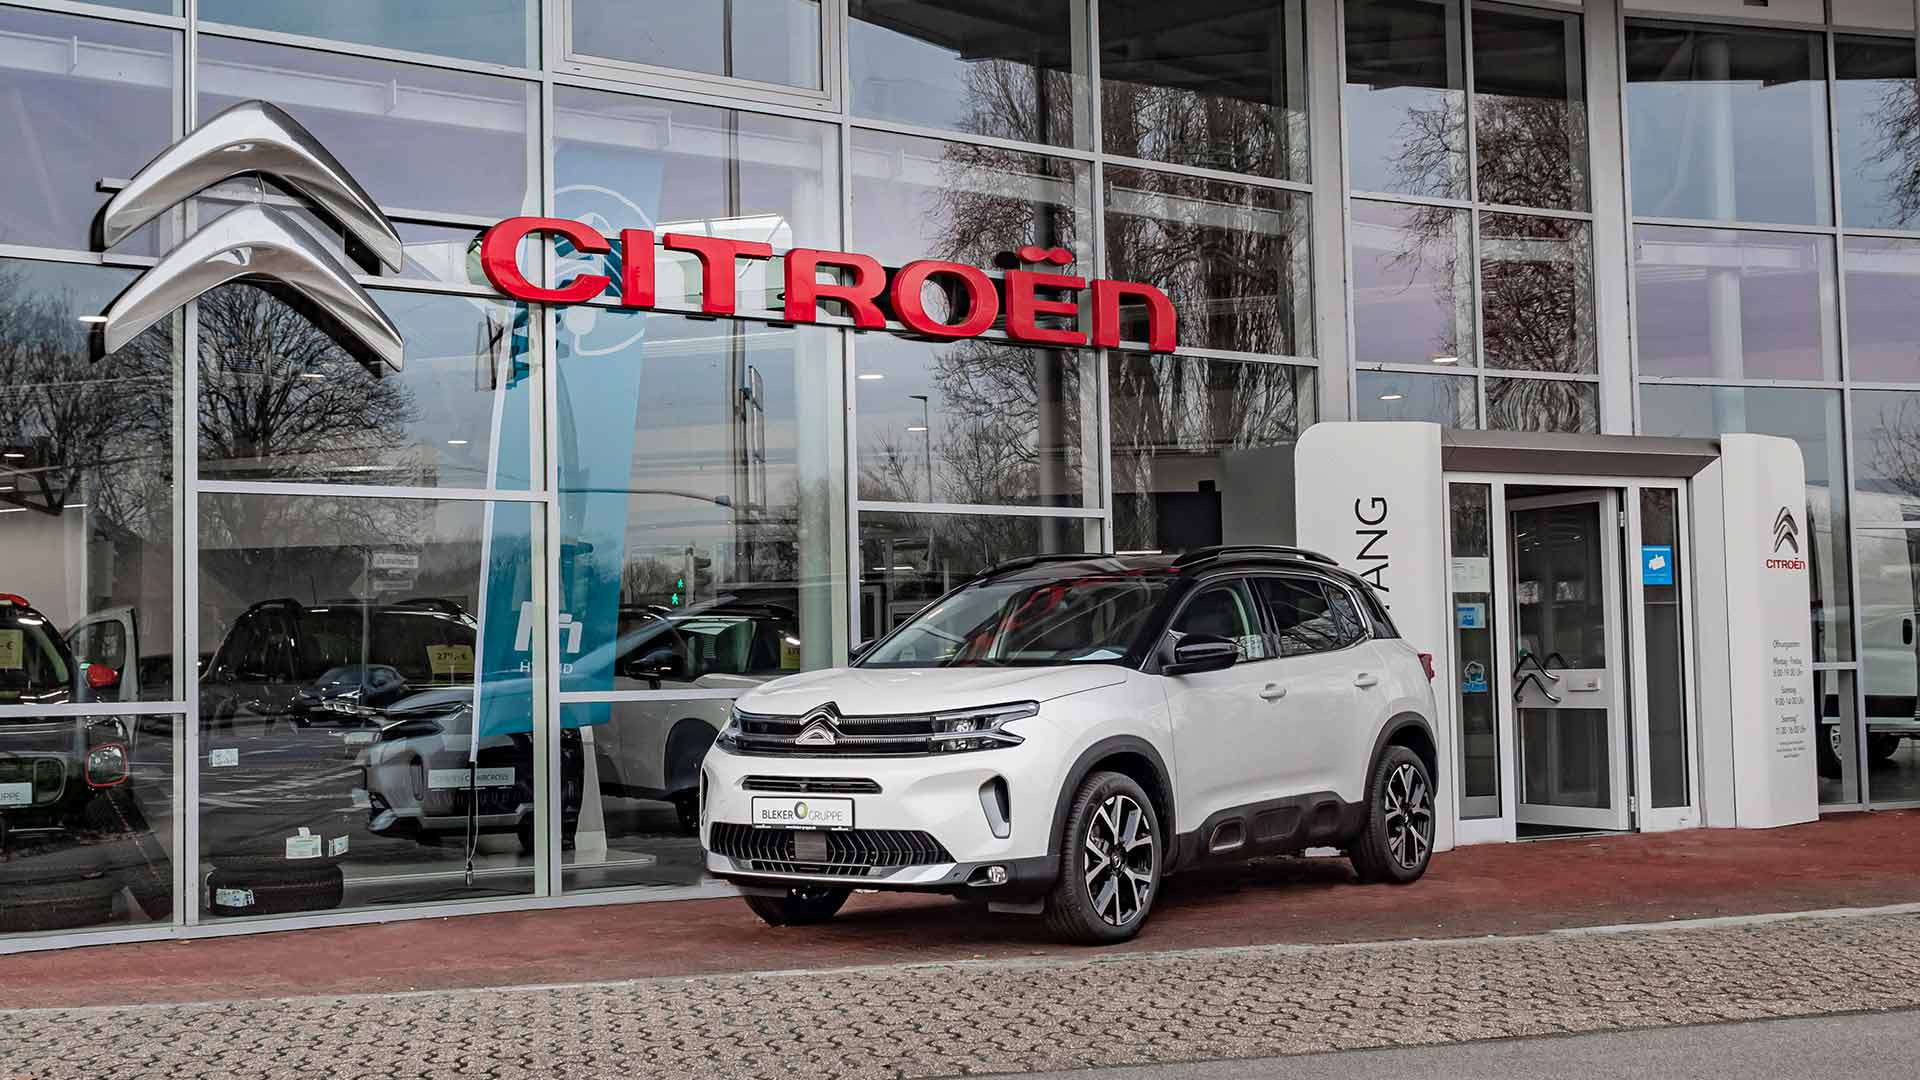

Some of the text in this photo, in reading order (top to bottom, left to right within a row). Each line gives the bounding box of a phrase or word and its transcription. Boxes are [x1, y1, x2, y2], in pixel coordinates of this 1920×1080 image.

[481, 216, 1176, 352] CITROËN
[1355, 497, 1390, 609] ANG
[1766, 557, 1806, 570] CITROËN
[762, 809, 843, 822] BLEKER GRUPPE
